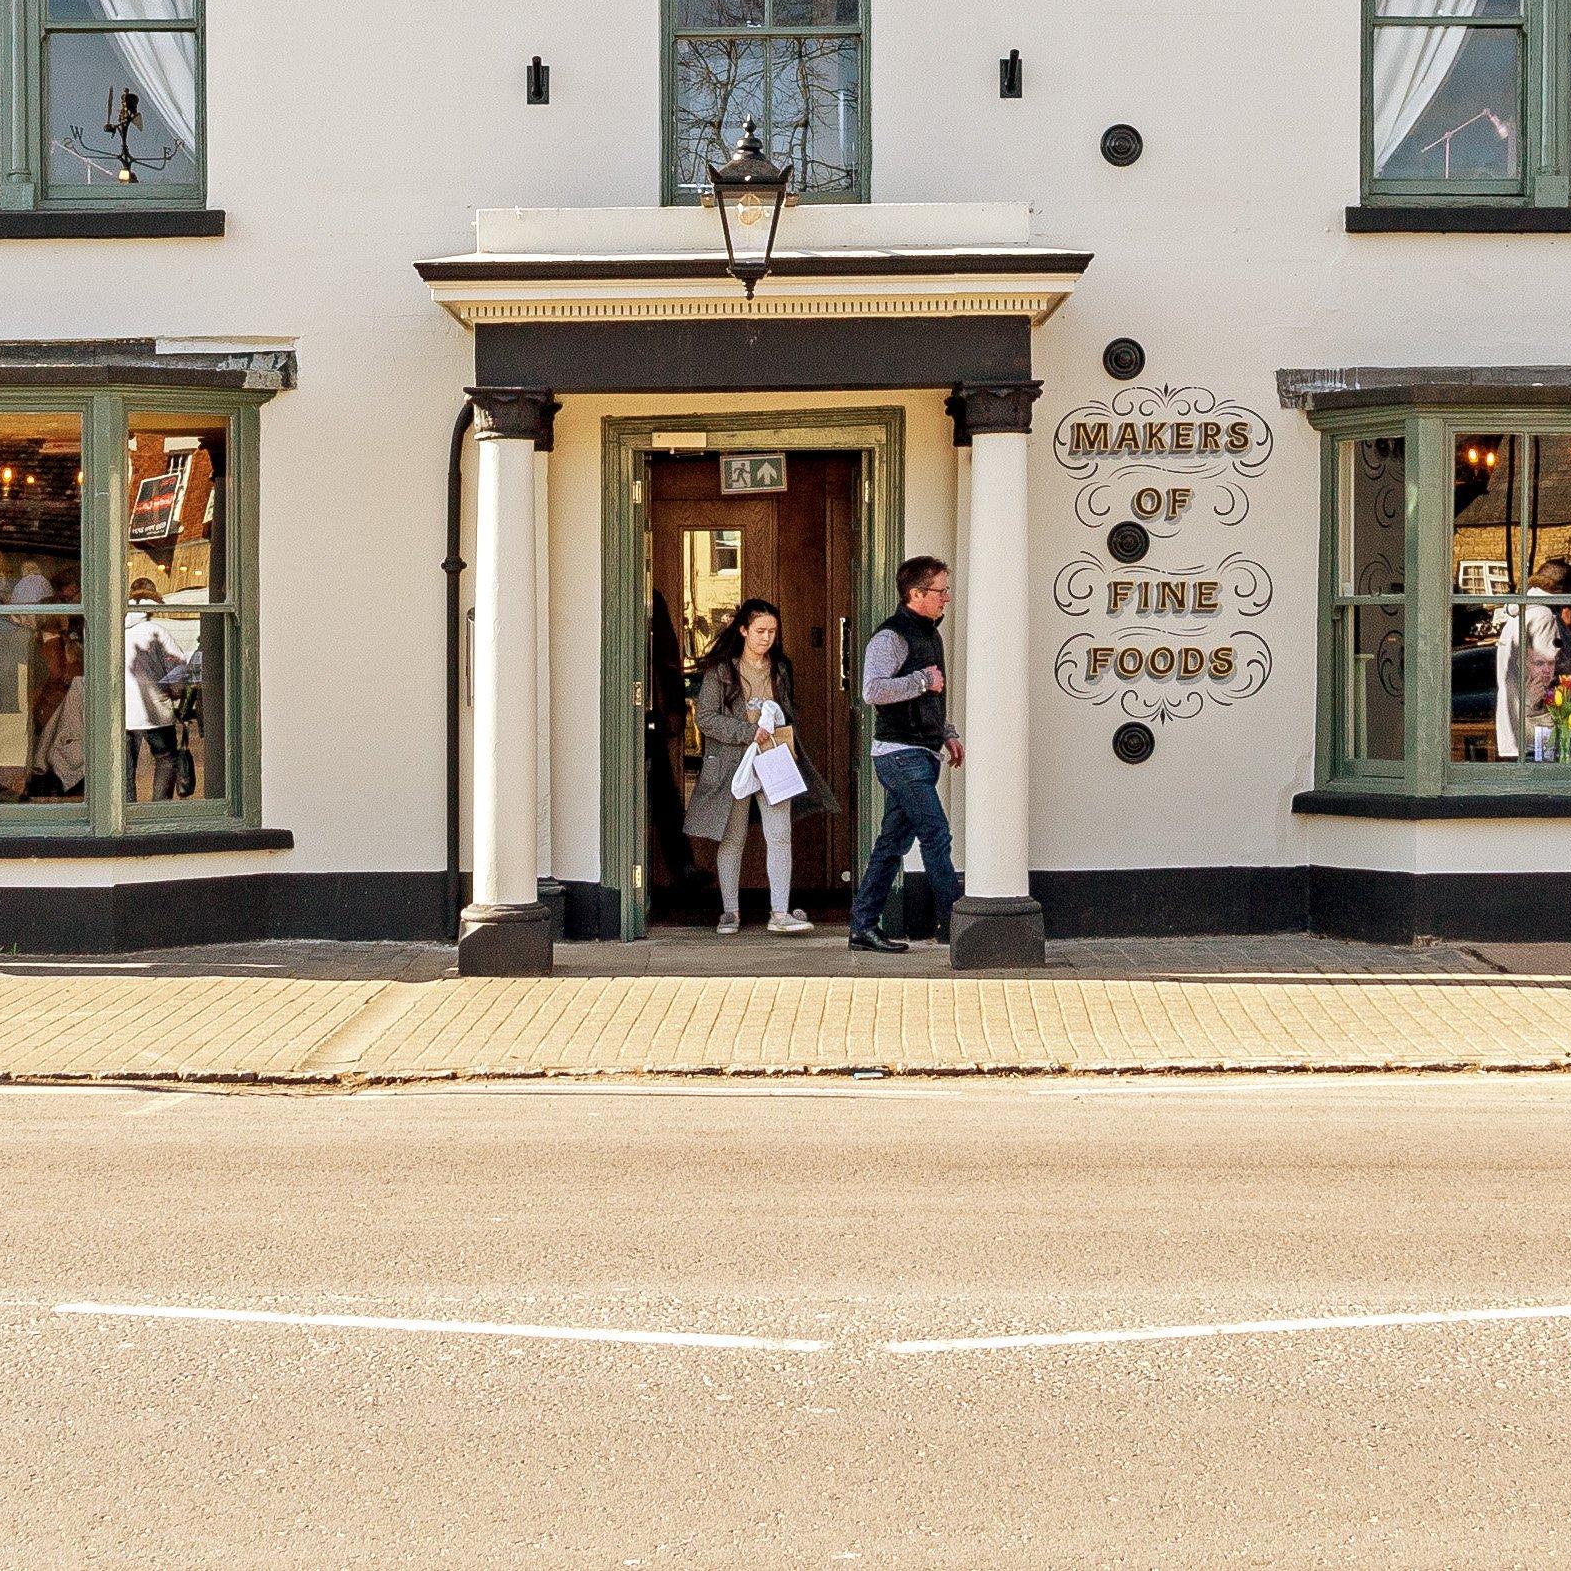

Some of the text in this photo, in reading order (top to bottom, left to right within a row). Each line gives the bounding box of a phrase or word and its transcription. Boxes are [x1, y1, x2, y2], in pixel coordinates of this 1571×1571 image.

[1069, 421, 1252, 457] MAKERS
[1131, 486, 1195, 521] OF
[1107, 580, 1222, 617] FINE
[1085, 646, 1237, 684] FOODS
